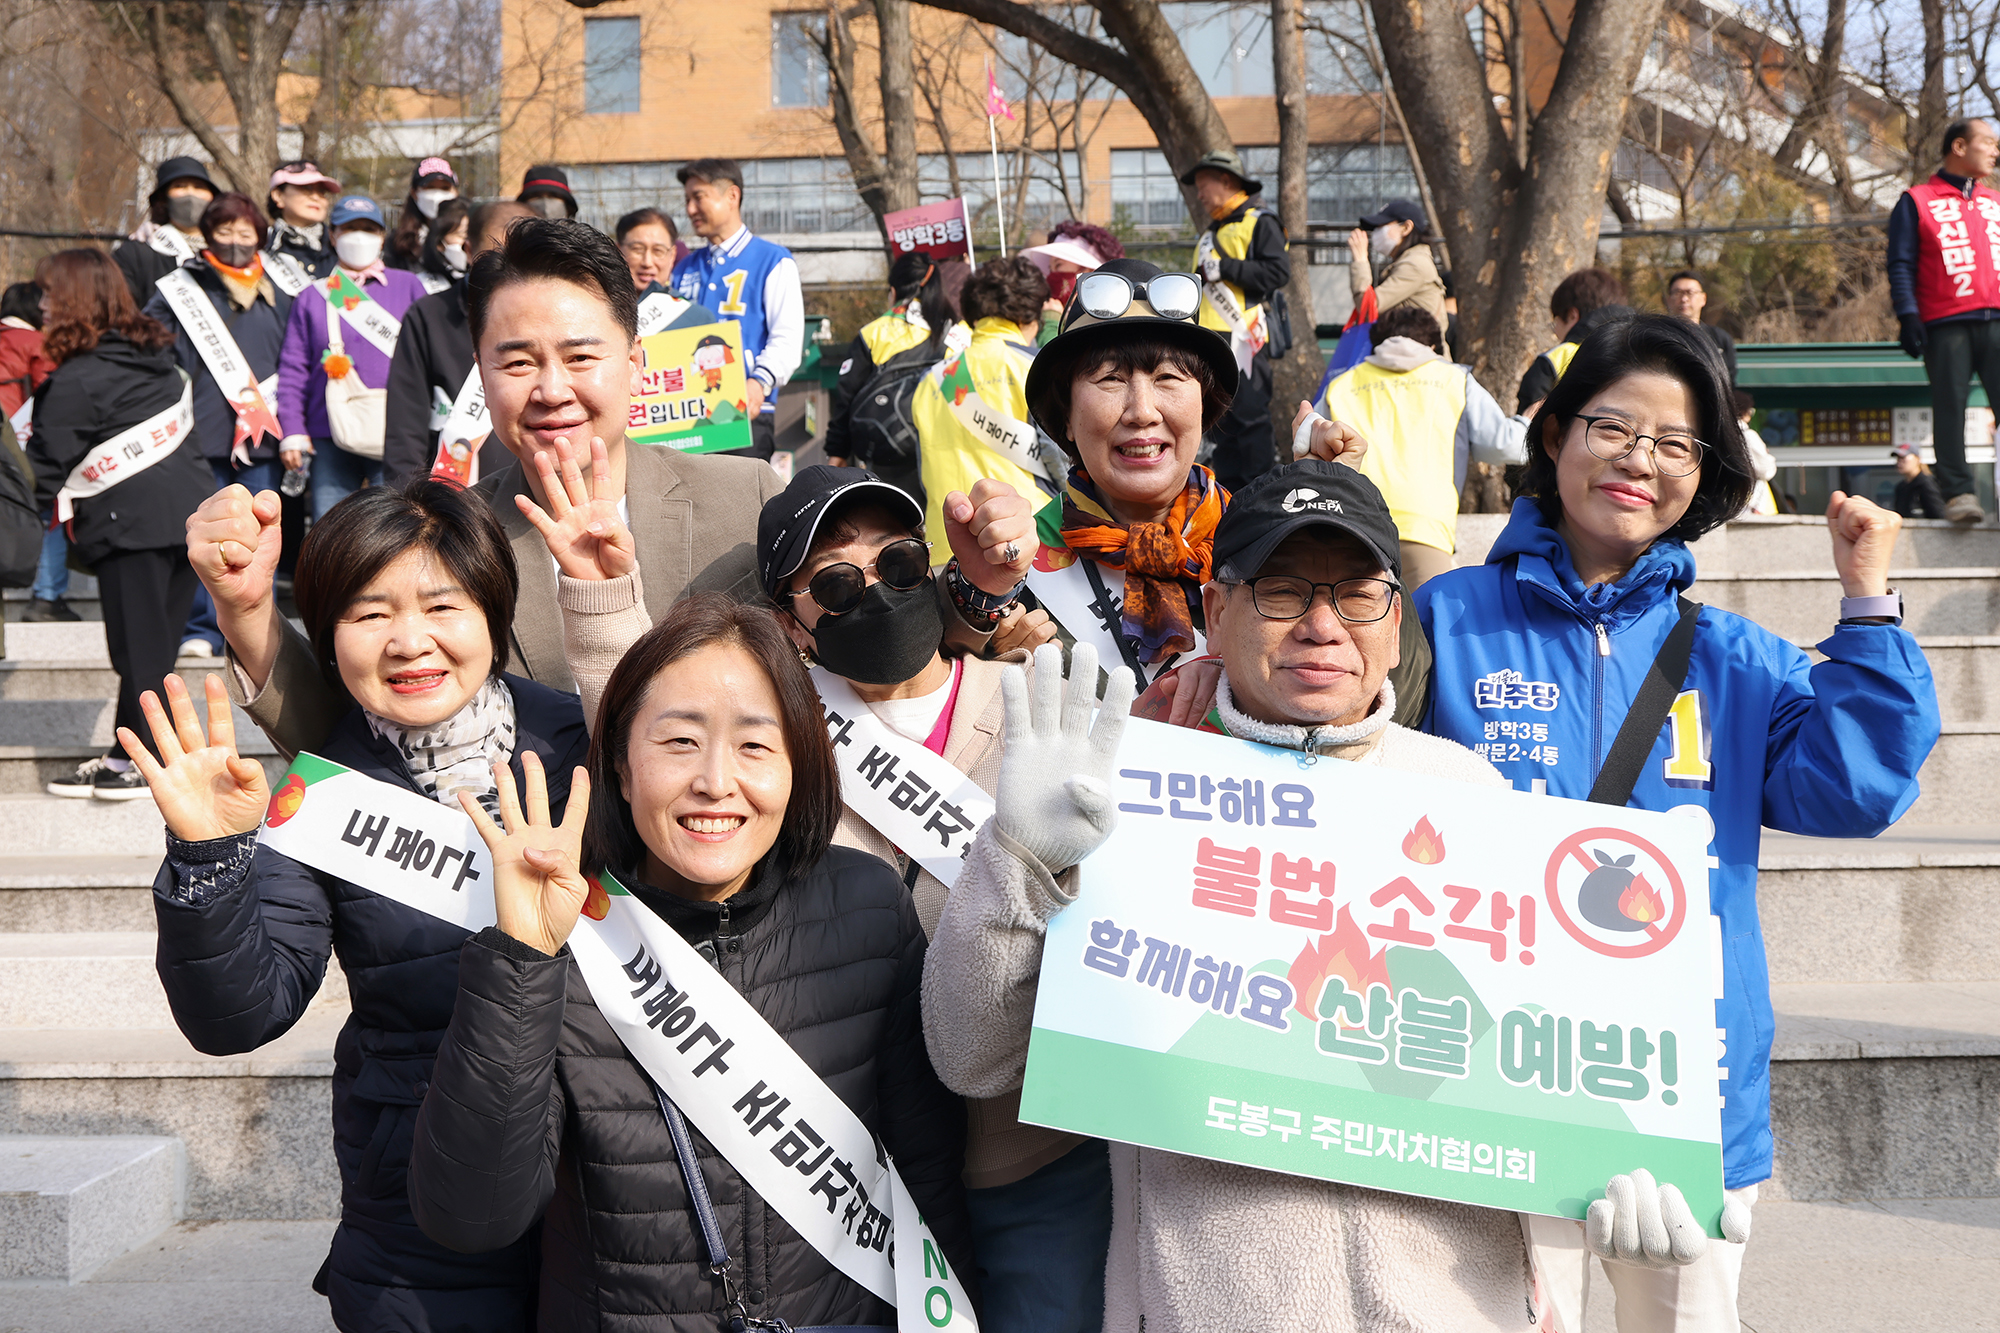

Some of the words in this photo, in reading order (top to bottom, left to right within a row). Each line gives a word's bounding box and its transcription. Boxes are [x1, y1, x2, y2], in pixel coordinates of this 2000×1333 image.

[893, 217, 964, 252] 방학3동
[718, 269, 749, 316] 1
[973, 409, 1019, 449] 도봉구
[1307, 502, 1343, 514] NEPA
[1478, 681, 1557, 709] 민주당
[1484, 721, 1549, 742] 방학3동
[1663, 689, 1713, 787] 1
[1118, 768, 1317, 828] 그만해요
[340, 808, 481, 892] 도봉구
[1192, 836, 1337, 932] 불법
[1366, 876, 1537, 966] 소각!
[621, 943, 735, 1078] 도봉구
[1083, 919, 1294, 1030] 함께해요
[1316, 977, 1473, 1078] 산불
[1499, 1008, 1680, 1106] 예방!
[1205, 1097, 1302, 1143] 도봉구
[1310, 1113, 1537, 1184] 주민자치협의회
